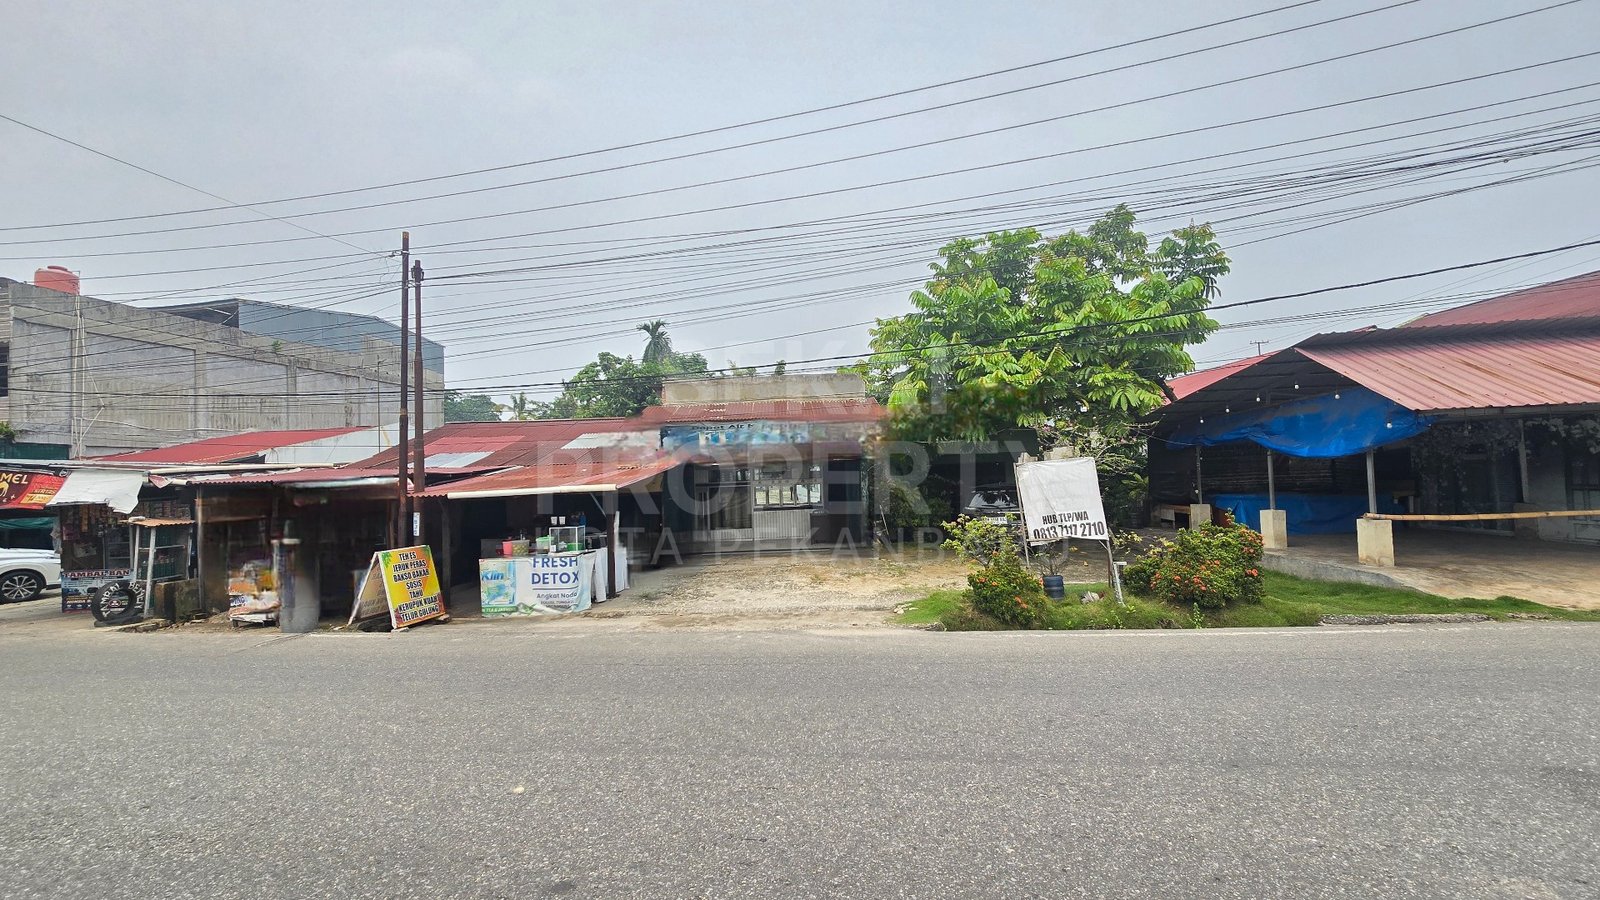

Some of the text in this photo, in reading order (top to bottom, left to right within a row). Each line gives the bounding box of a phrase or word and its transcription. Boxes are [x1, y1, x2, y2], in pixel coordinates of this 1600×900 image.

[1042, 511, 1089, 525] HUB TLP/WA
[1033, 521, 1105, 539] 0813 7117 2710
[399, 551, 417, 561] TEH ES
[393, 559, 426, 572] JERUK PERAS
[532, 557, 578, 568] FRESH
[393, 572, 411, 582] BAKSO
[531, 570, 579, 585] DETOX
[406, 580, 422, 590] SOSIS
[409, 590, 423, 599] TAHU
[537, 592, 560, 600] Angkat
[398, 598, 424, 612] KERUPUK
[401, 605, 439, 621] TELUR GULUNG
